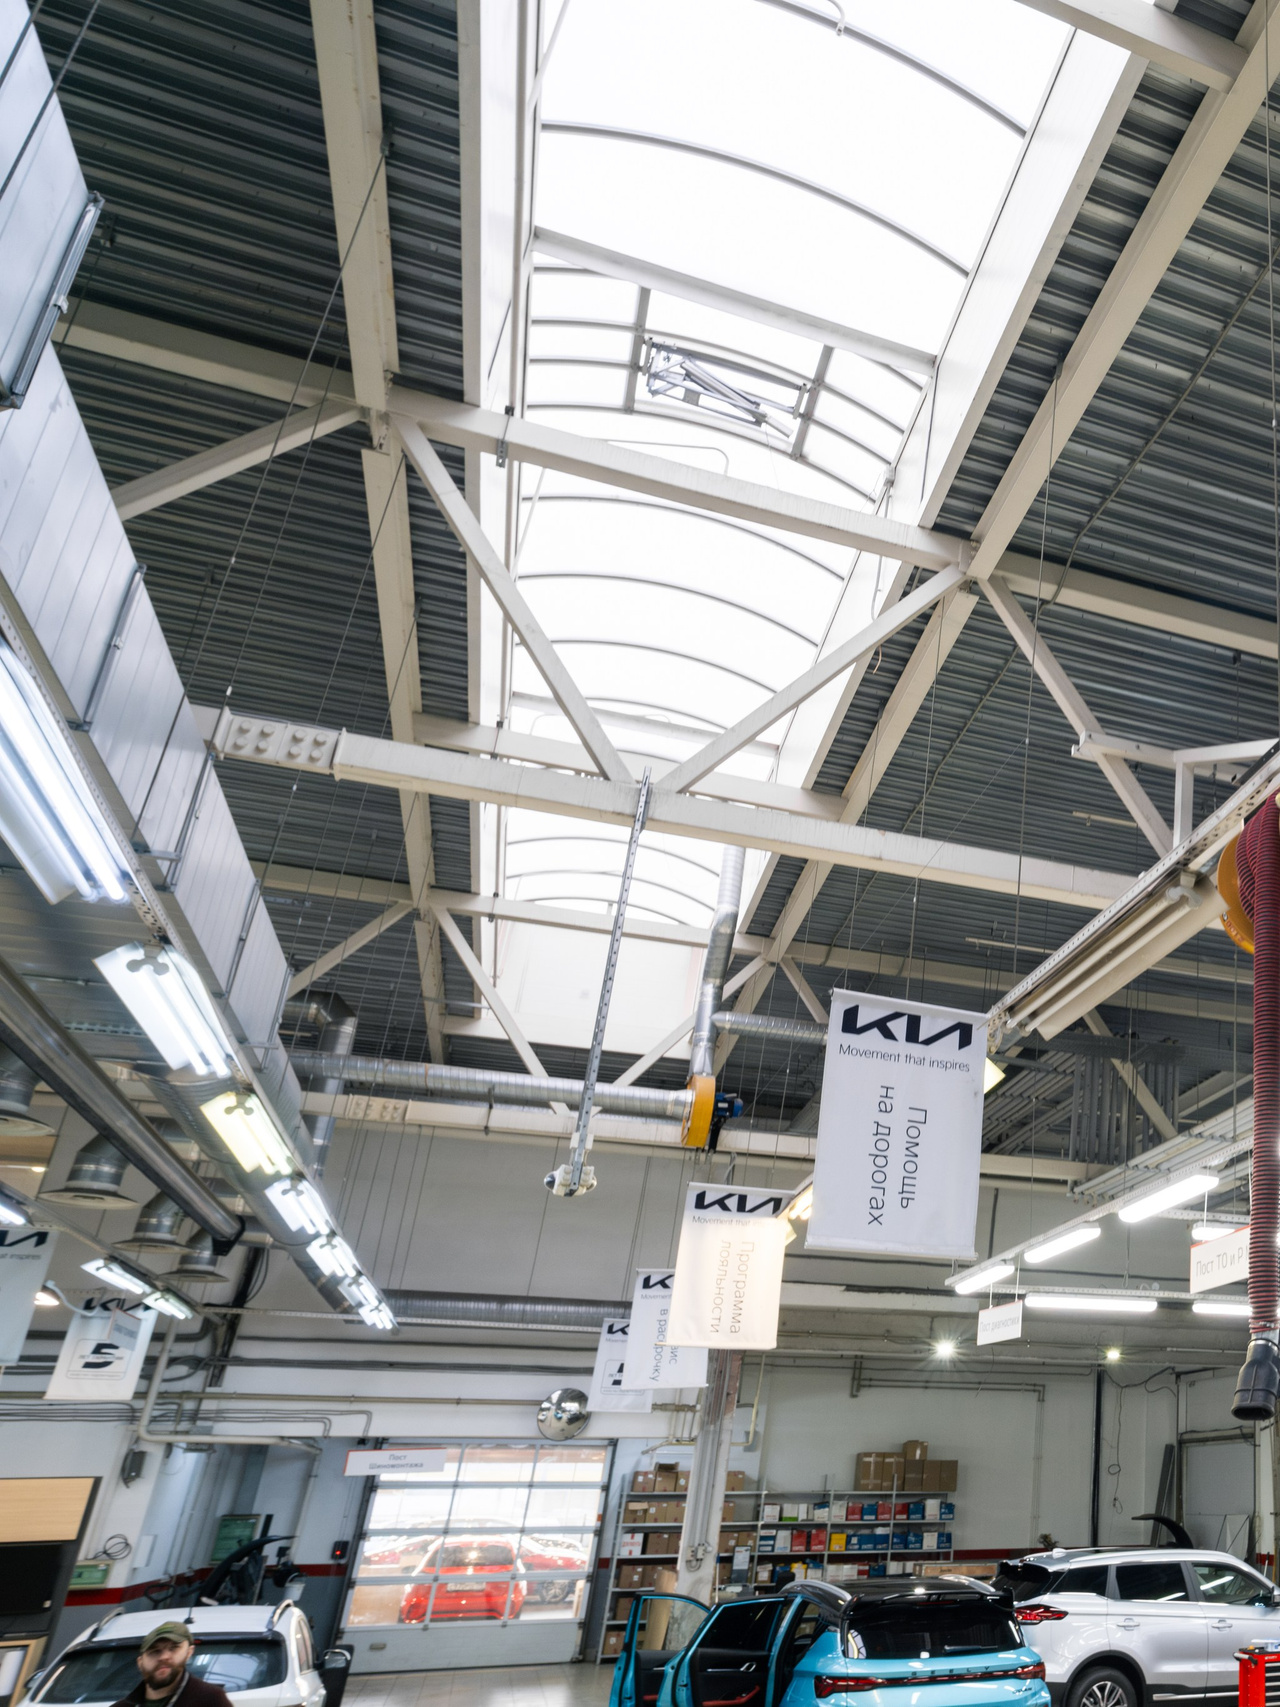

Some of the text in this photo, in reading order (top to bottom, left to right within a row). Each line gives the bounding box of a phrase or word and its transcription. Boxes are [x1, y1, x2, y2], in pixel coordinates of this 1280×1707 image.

[841, 1004, 973, 1050] KIA
[839, 1044, 970, 1072] Movement that inspires
[867, 1085, 895, 1226] на дорогах
[898, 1106, 928, 1209] Помощь
[692, 1215, 733, 1226] Movement
[735, 1219, 751, 1227] that
[694, 1190, 783, 1216] KIA
[1195, 1260, 1214, 1277] Пост
[1216, 1252, 1228, 1270] ТО
[1230, 1255, 1235, 1265] и
[710, 1239, 732, 1333] лояльности
[730, 1241, 755, 1334] Программа
[649, 1319, 667, 1382] расрочку
[369, 1462, 424, 1470] Шиномонтажа
[911, 1666, 990, 1676] GEELY
